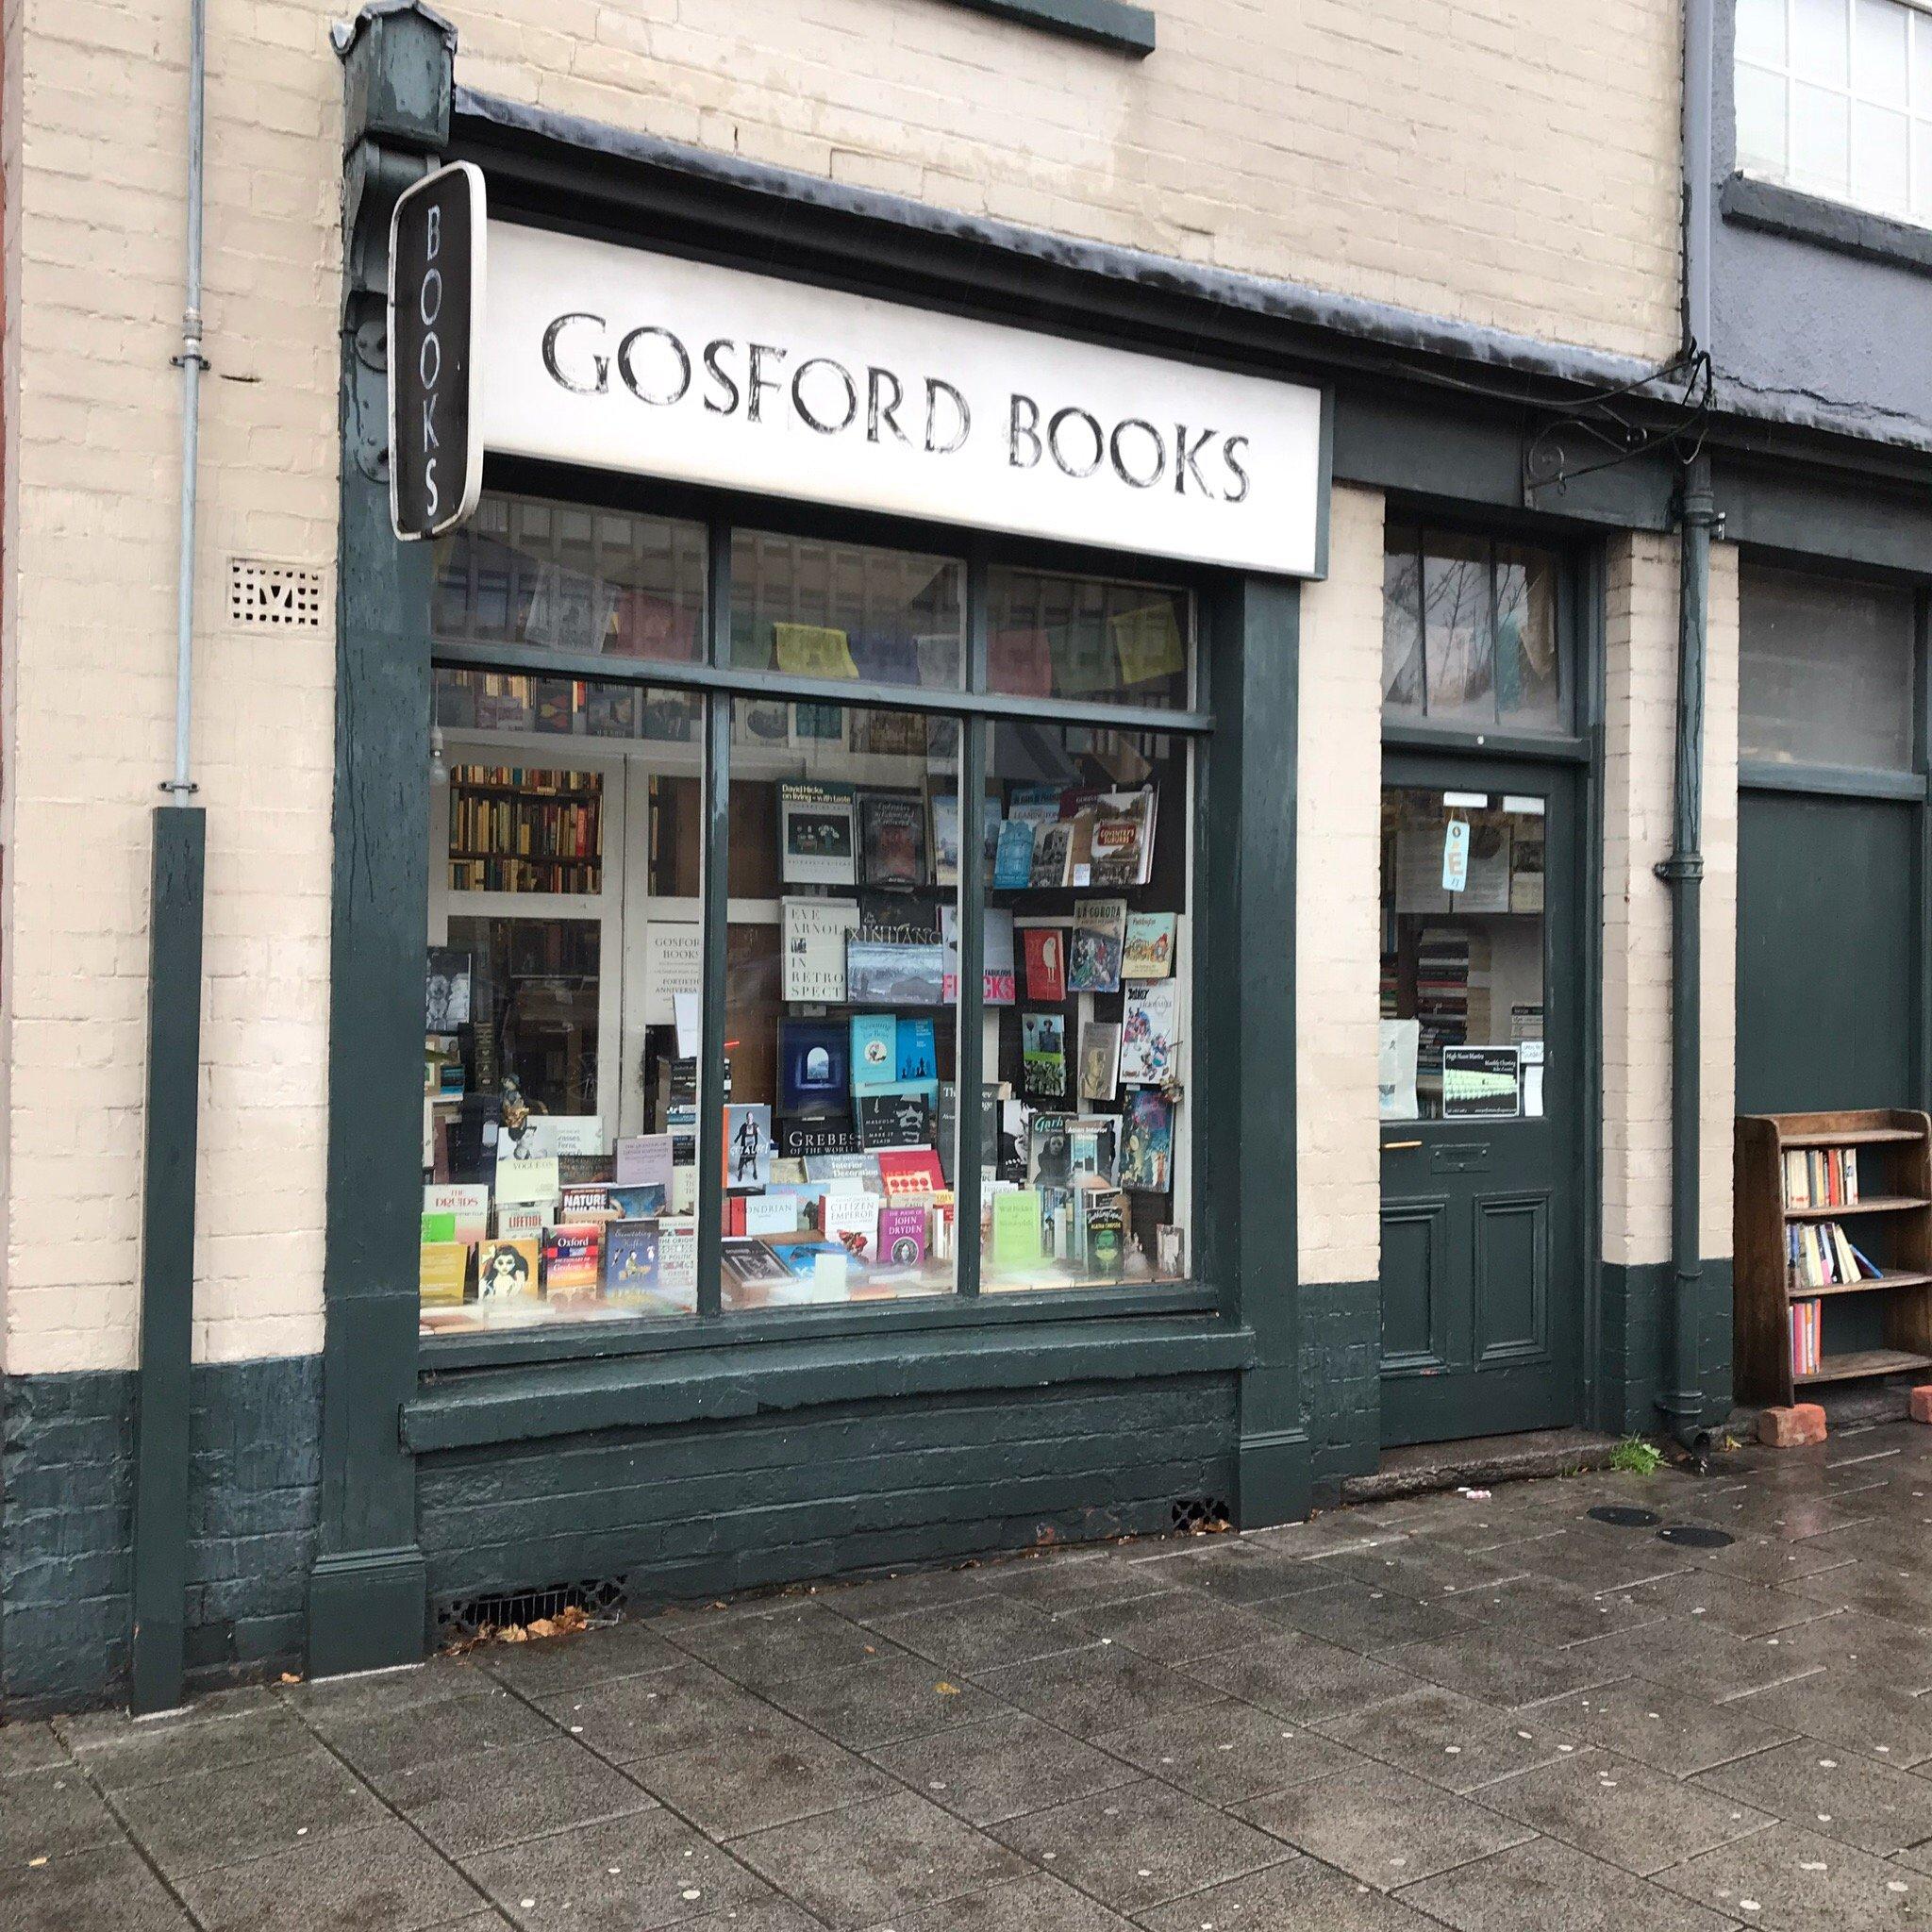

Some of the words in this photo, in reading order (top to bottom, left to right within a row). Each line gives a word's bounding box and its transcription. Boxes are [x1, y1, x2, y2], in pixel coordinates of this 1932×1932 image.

[420, 206, 441, 516] BOOKS
[541, 312, 970, 455] GOSFORD
[1008, 393, 1251, 504] BOOKS
[782, 784, 803, 792] David
[792, 923, 843, 936] ARNOL
[655, 937, 699, 947] GOSFOR
[791, 973, 843, 984] RETRO
[791, 987, 841, 997] SPECT
[833, 1169, 878, 1178] Decoration
[436, 1197, 479, 1208] DRUIDS
[564, 1192, 608, 1207] NATURE
[831, 1202, 874, 1212] CITIZEN
[831, 1211, 874, 1221] EMPEROR
[894, 1216, 917, 1225] JOHN
[889, 1225, 923, 1235] DRYDEN
[558, 1236, 590, 1247] Oxford
